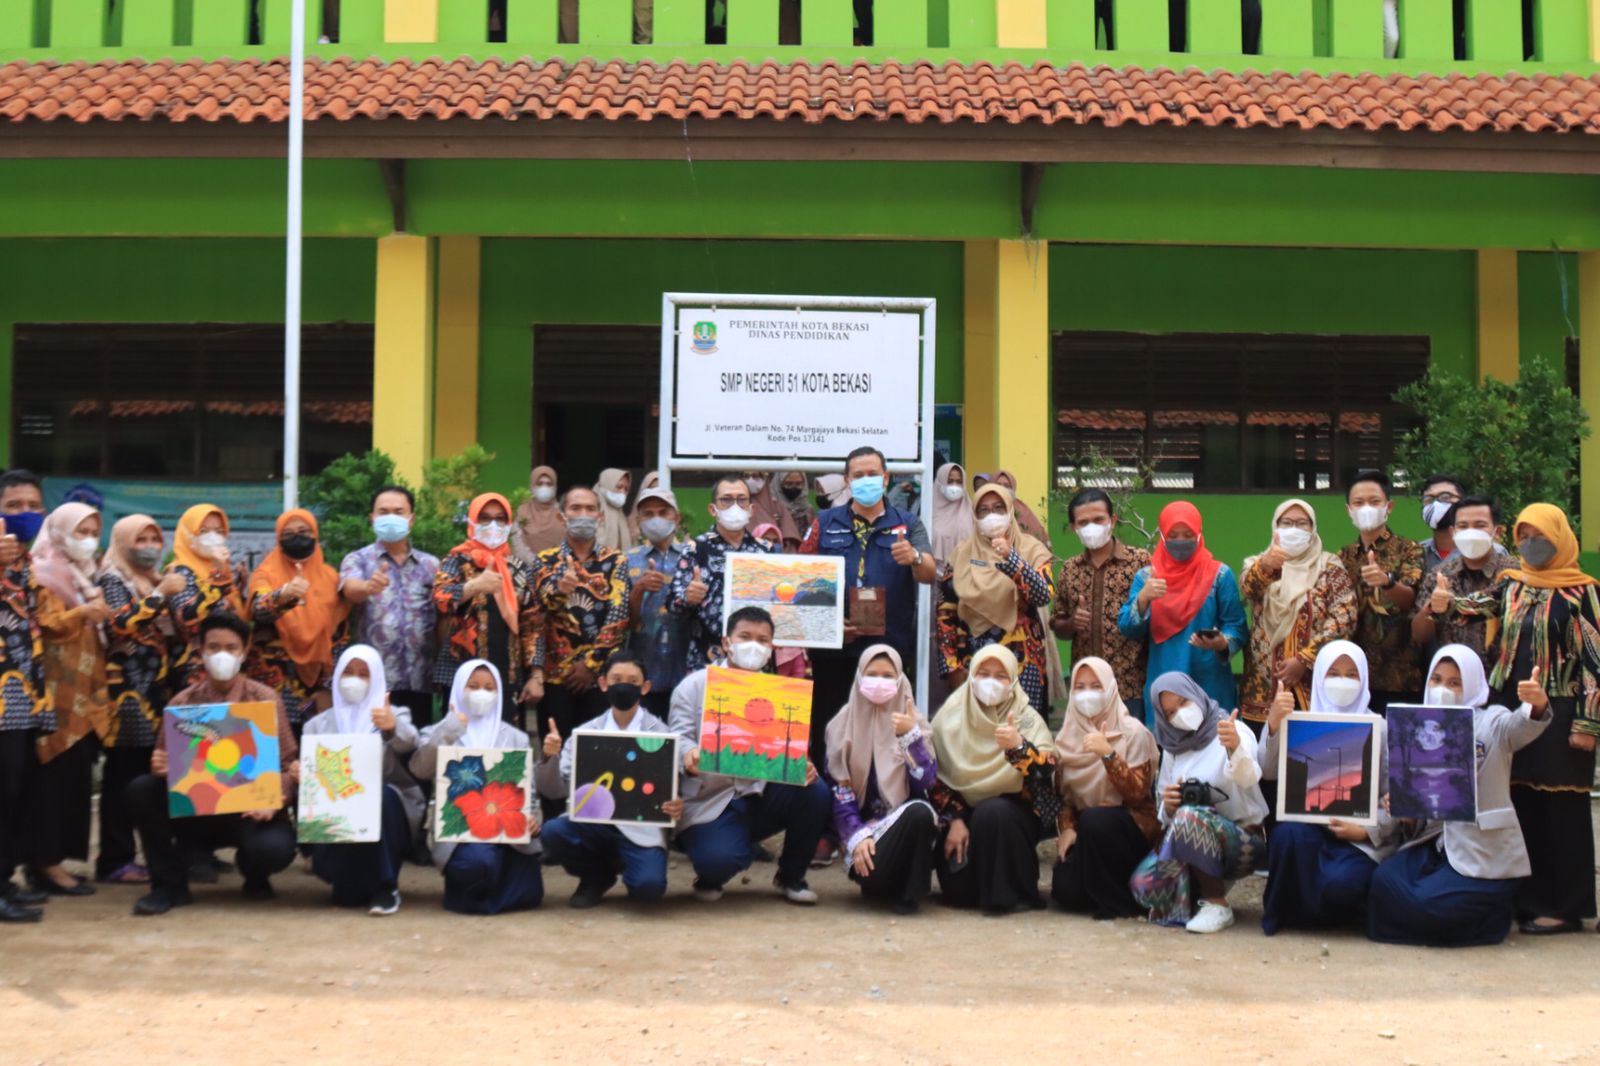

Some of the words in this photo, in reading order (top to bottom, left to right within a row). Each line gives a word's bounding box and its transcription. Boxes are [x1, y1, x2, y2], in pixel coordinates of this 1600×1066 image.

[729, 320, 799, 330] PEMERINTAH
[801, 321, 830, 331] KOTA
[832, 322, 870, 332] BEKASI
[748, 330, 781, 339] DINAS
[783, 331, 850, 341] PENDIDIKAN
[720, 372, 743, 392] SMP
[746, 373, 785, 393] NEGERI
[788, 374, 799, 392] 51
[802, 374, 829, 392] KOTA
[832, 374, 872, 393] BEKASI
[714, 424, 743, 432] Veteran
[746, 424, 768, 432] Dalam
[770, 425, 784, 433] No.
[786, 425, 795, 433] 74
[837, 426, 860, 434] Bekasi
[861, 427, 888, 435] Selatan
[767, 434, 786, 442] Kode
[803, 435, 825, 443] 17141
